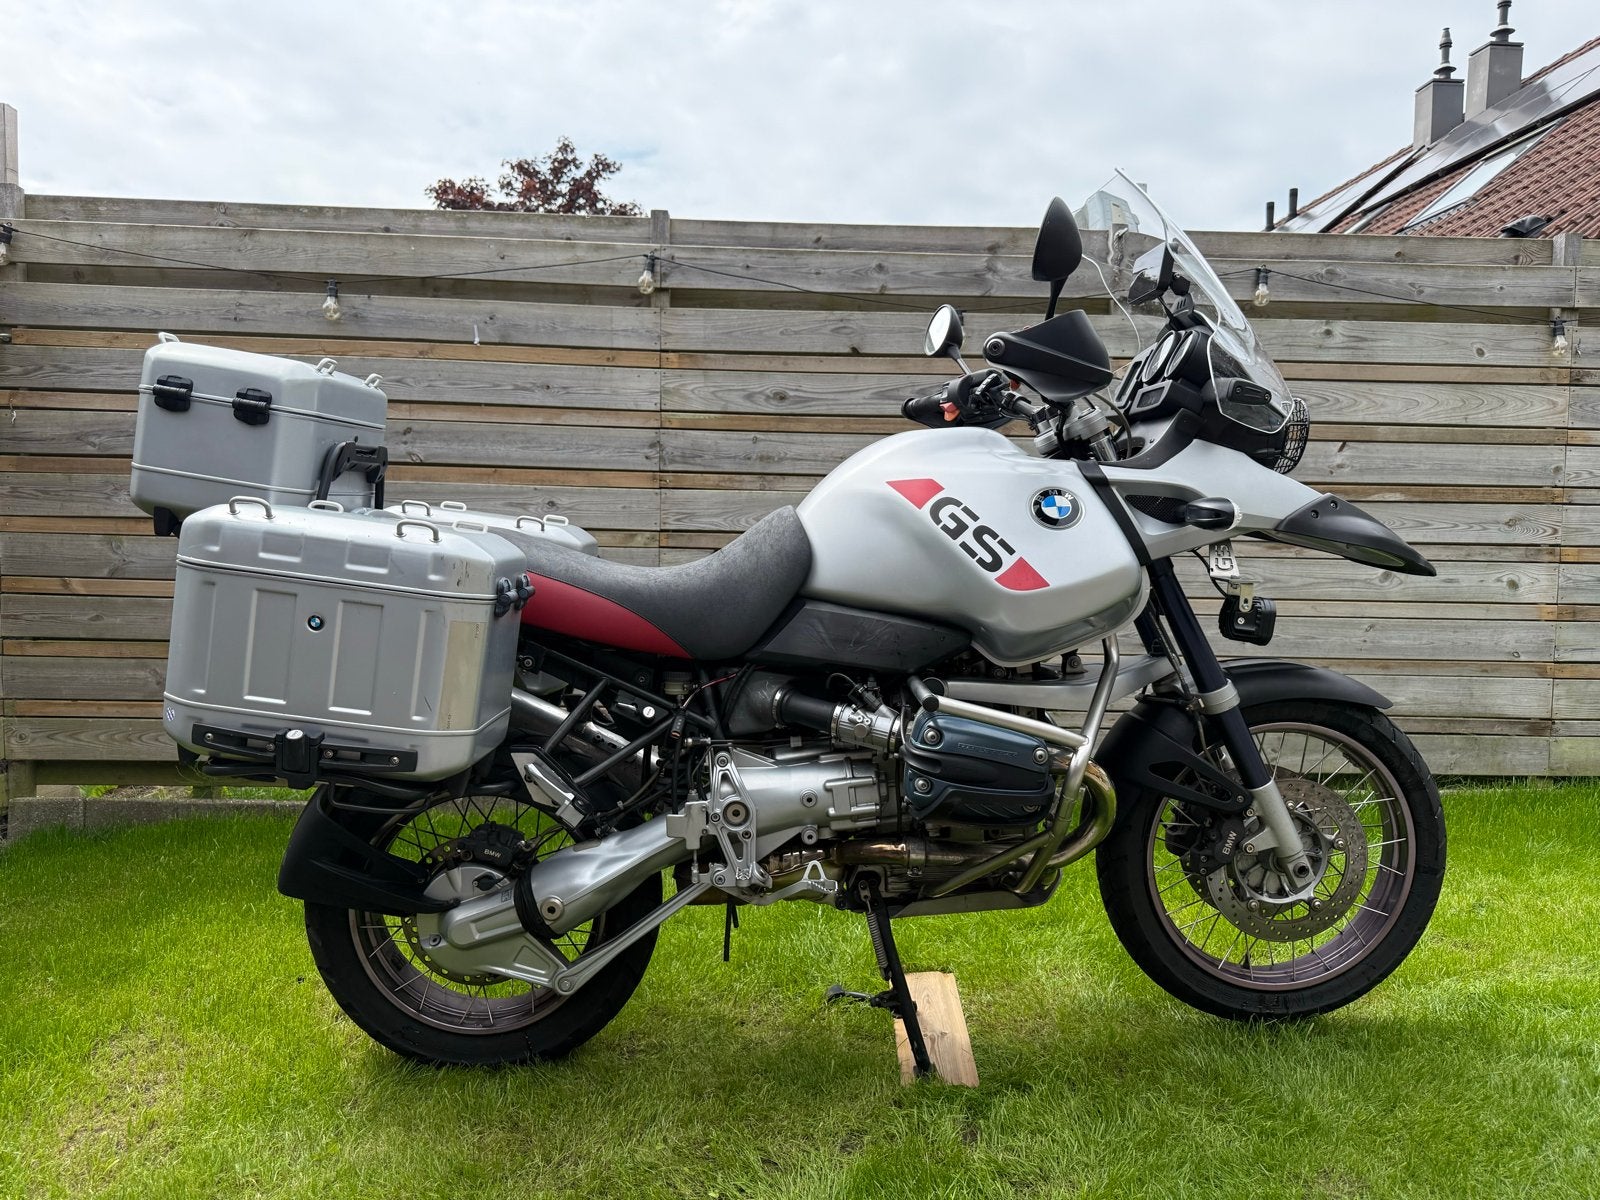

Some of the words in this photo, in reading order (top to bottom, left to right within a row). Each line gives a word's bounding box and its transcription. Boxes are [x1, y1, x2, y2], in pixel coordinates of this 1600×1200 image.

[1036, 488, 1074, 502] BMW
[929, 496, 1016, 573] GS
[1214, 545, 1234, 571] GS
[484, 848, 502, 858] BMW
[1222, 830, 1238, 855] BMW
